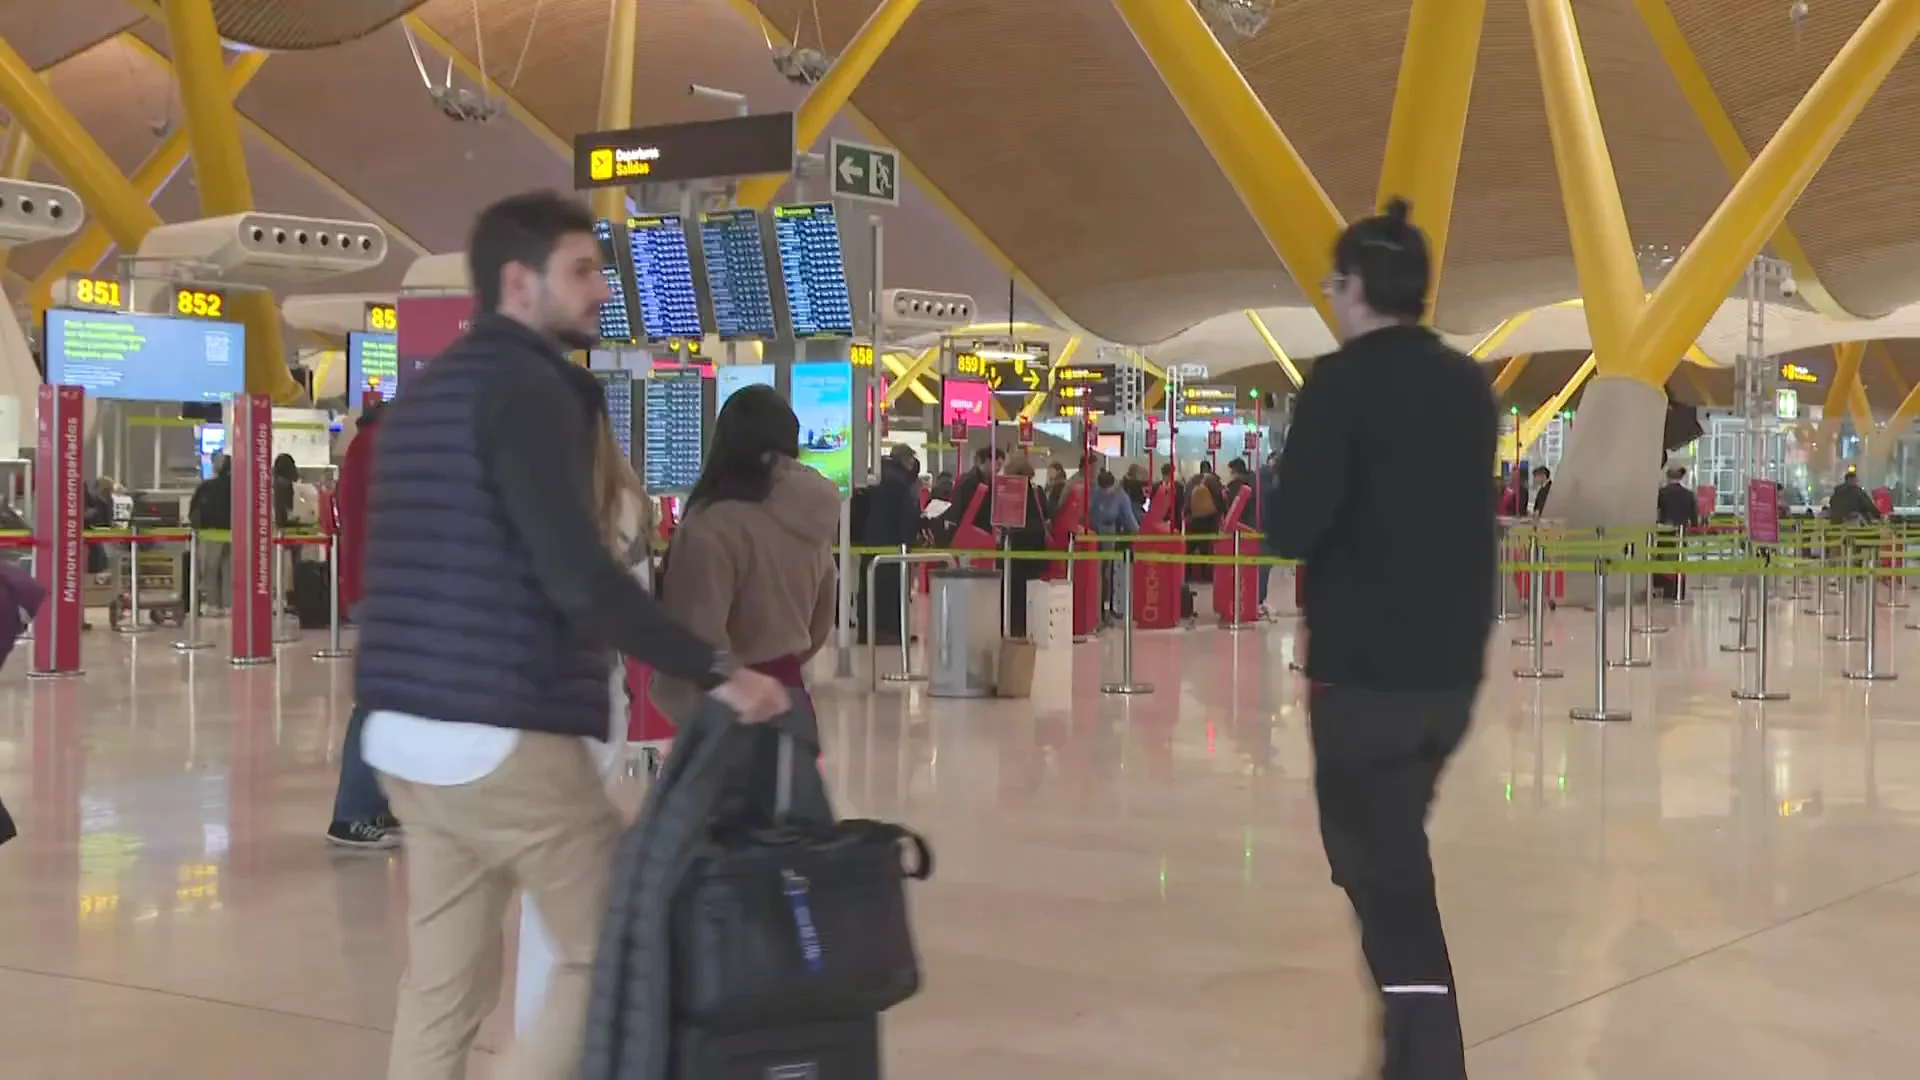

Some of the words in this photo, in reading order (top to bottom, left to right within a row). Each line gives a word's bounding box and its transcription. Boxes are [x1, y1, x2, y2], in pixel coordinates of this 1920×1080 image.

[615, 160, 650, 176] Salidas
[77, 278, 121, 306] 851
[177, 290, 222, 317] 852
[371, 306, 397, 330] 85
[958, 354, 979, 373] 859
[64, 417, 80, 516] acompañados
[67, 519, 77, 538] no
[64, 541, 77, 602] Menores
